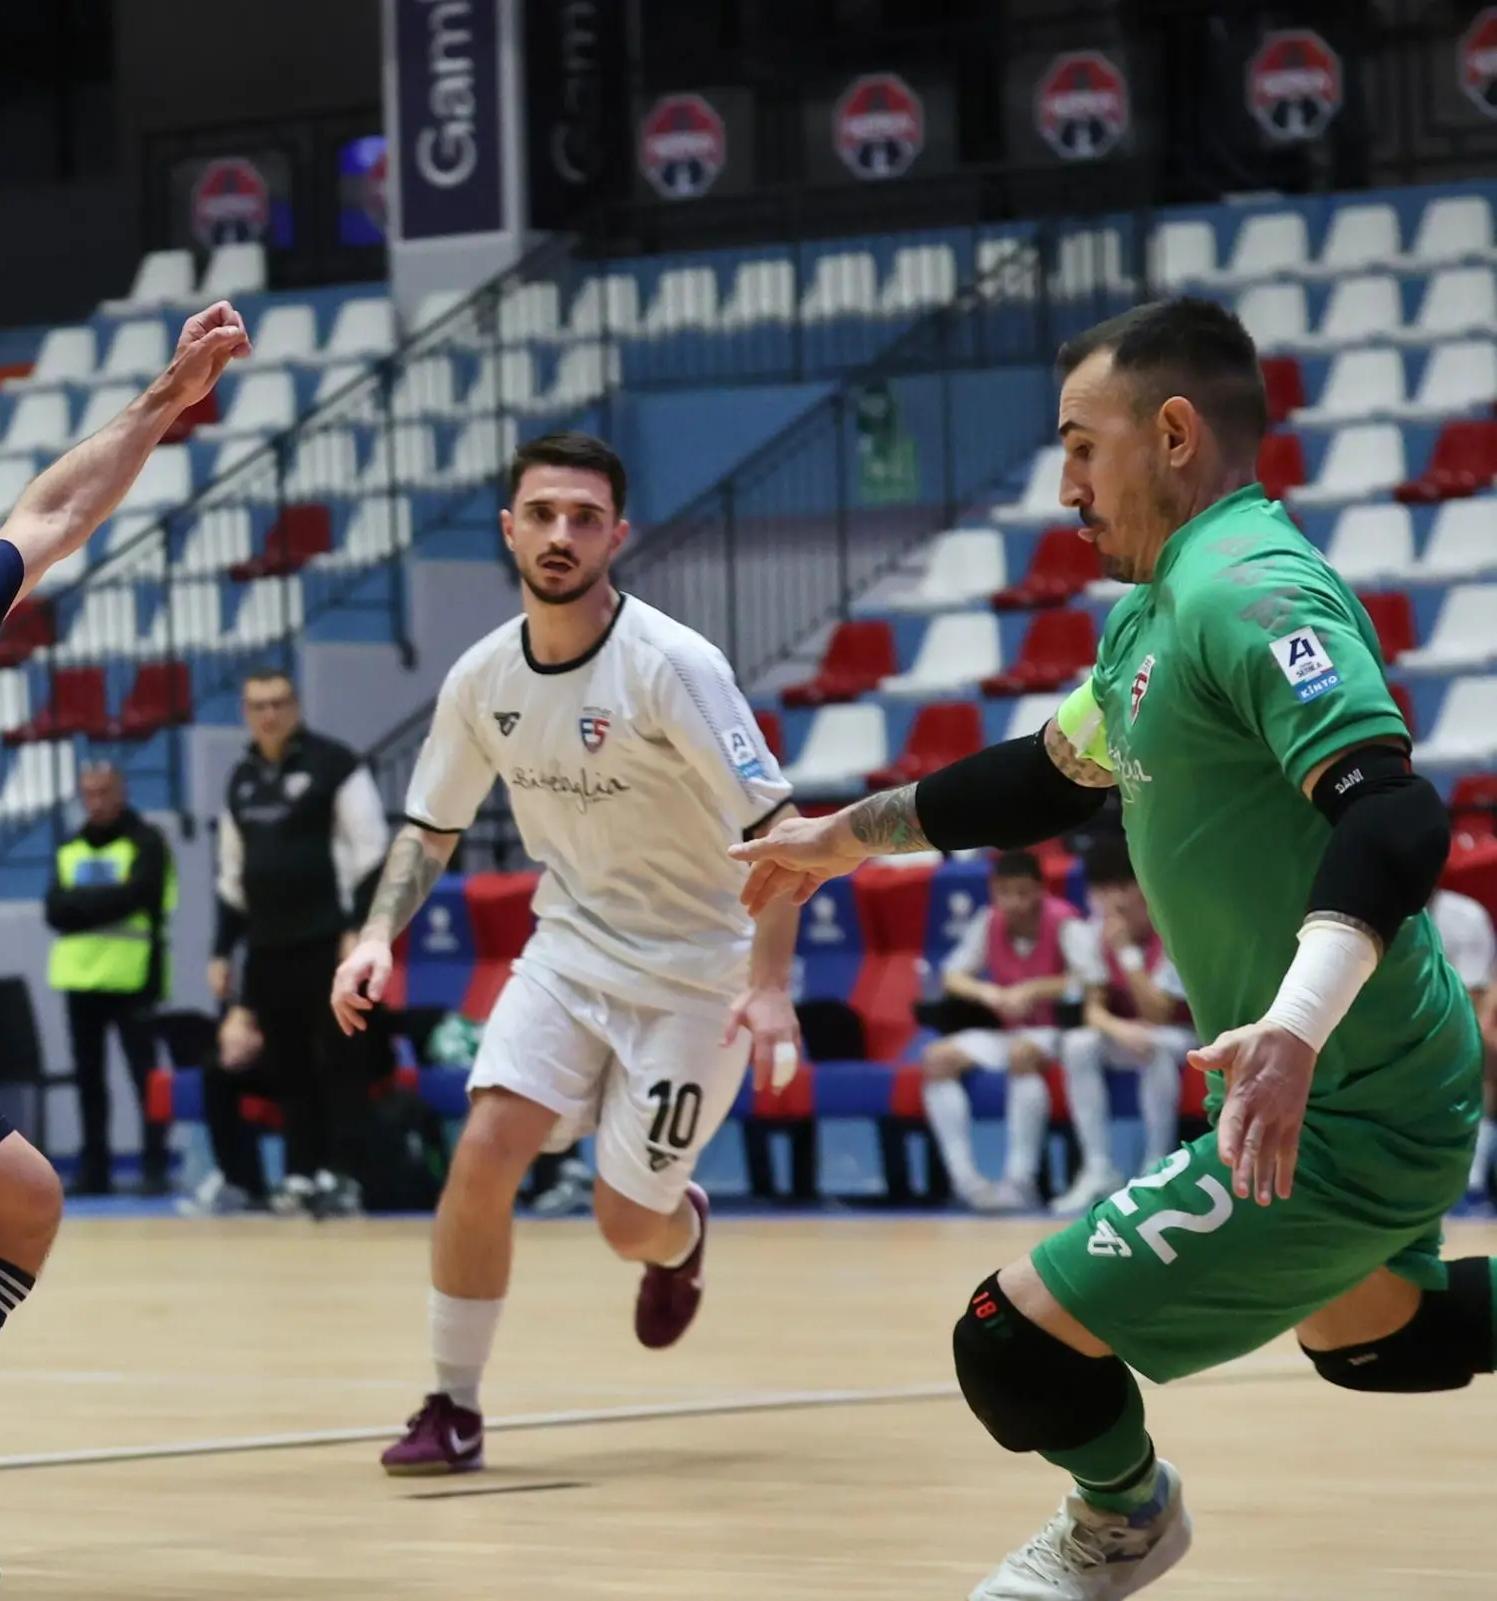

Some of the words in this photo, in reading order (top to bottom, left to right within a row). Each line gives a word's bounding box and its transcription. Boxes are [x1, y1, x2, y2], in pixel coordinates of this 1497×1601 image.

[1300, 675, 1338, 698] KINTO
[647, 1079, 703, 1149] 10
[1109, 1148, 1234, 1266] 22
